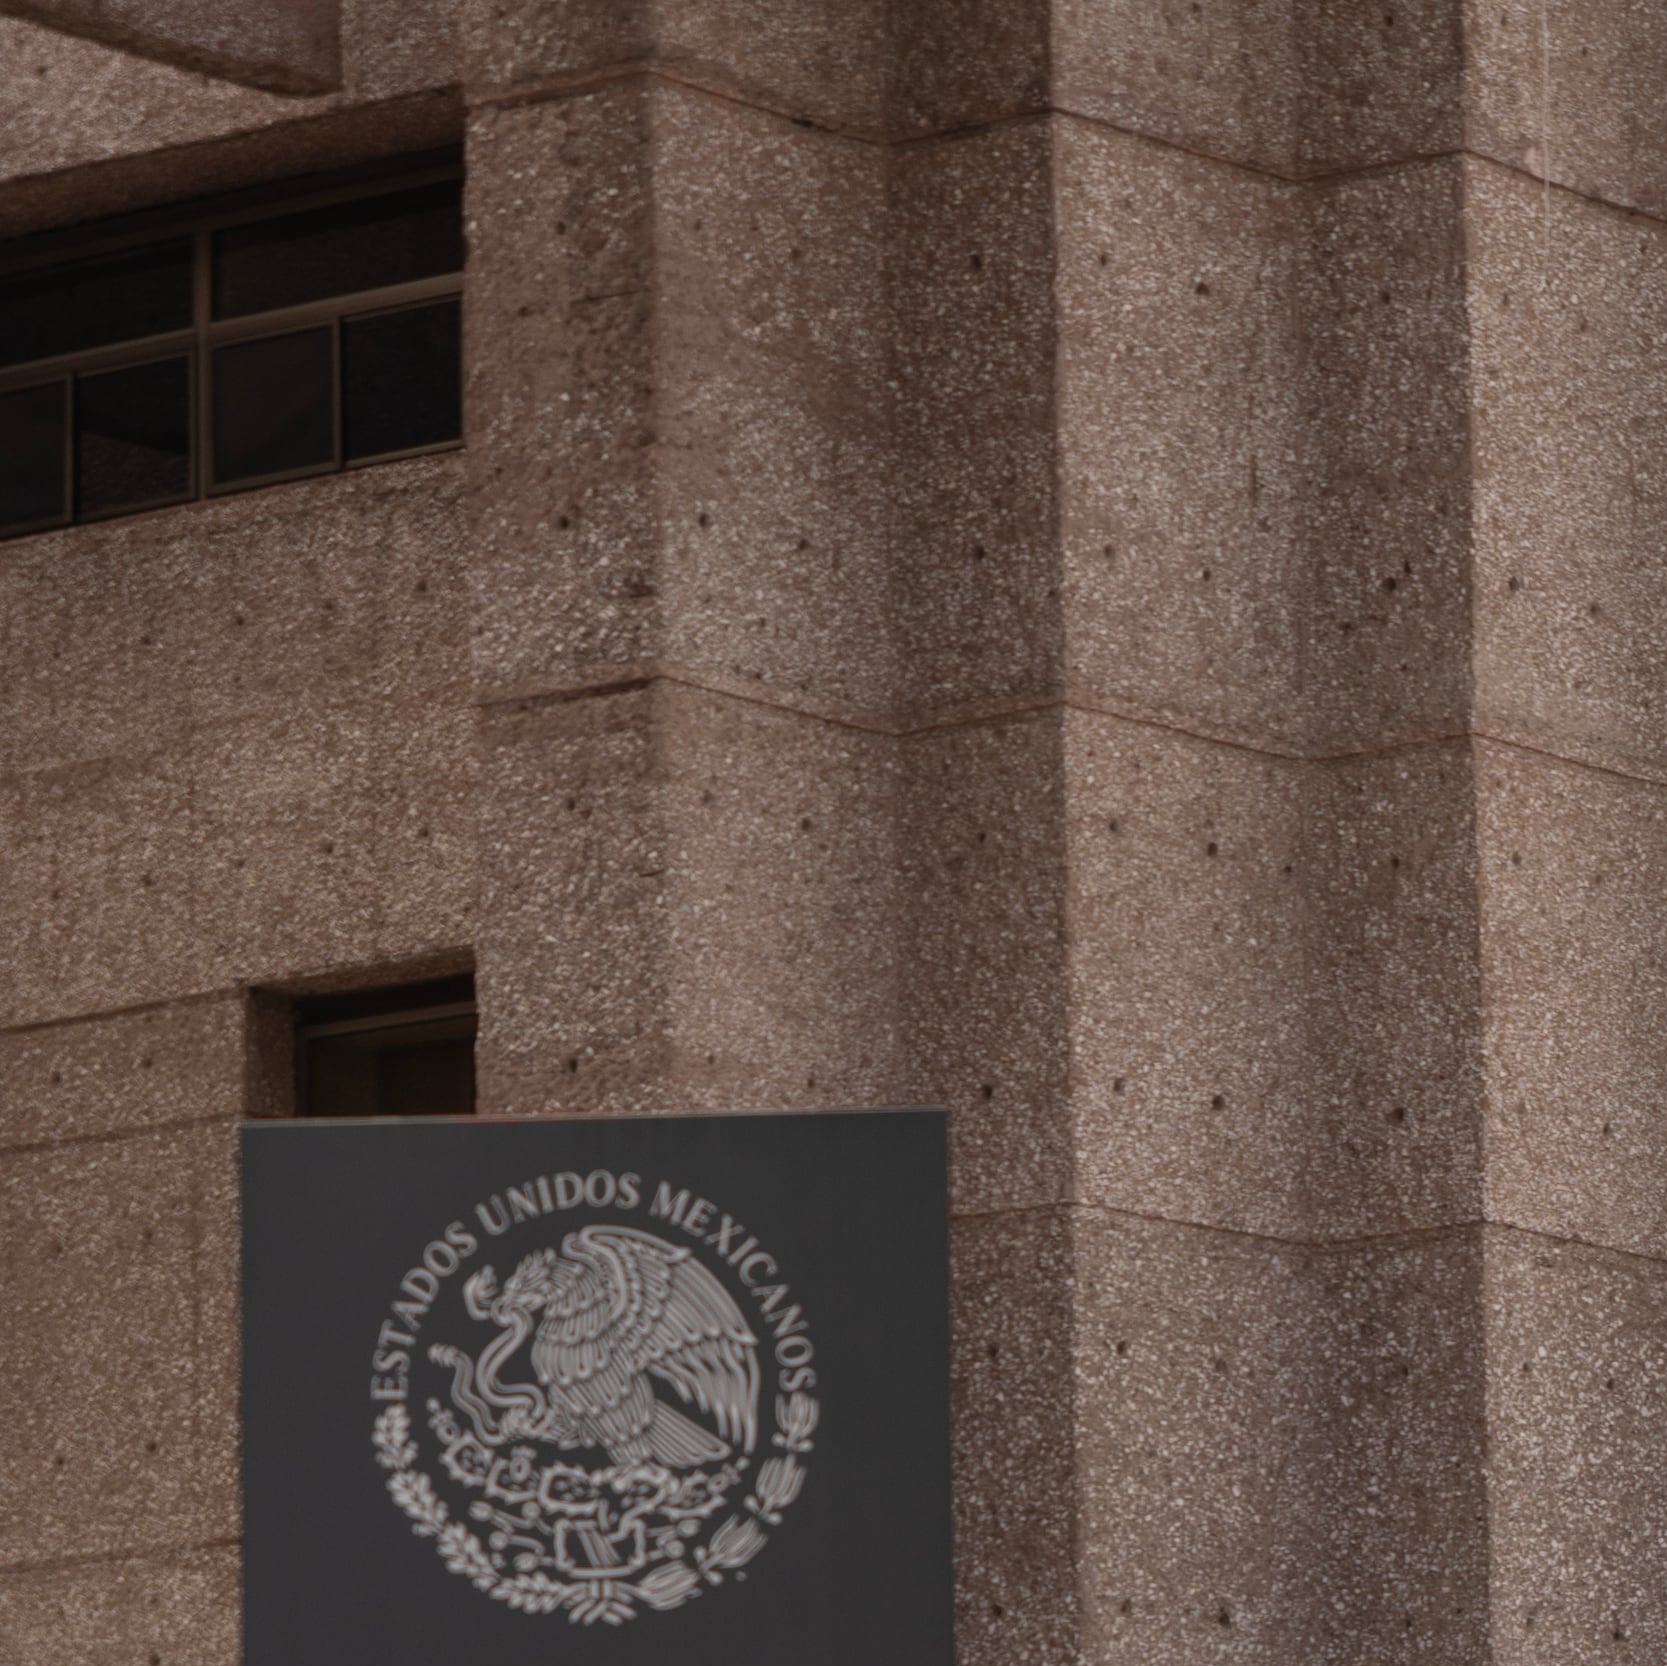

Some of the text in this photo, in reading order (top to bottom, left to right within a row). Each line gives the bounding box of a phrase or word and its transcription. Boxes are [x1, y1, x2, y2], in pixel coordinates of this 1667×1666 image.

[370, 1170, 819, 1401] ESTADOS UNIDOS MEXICANOS
